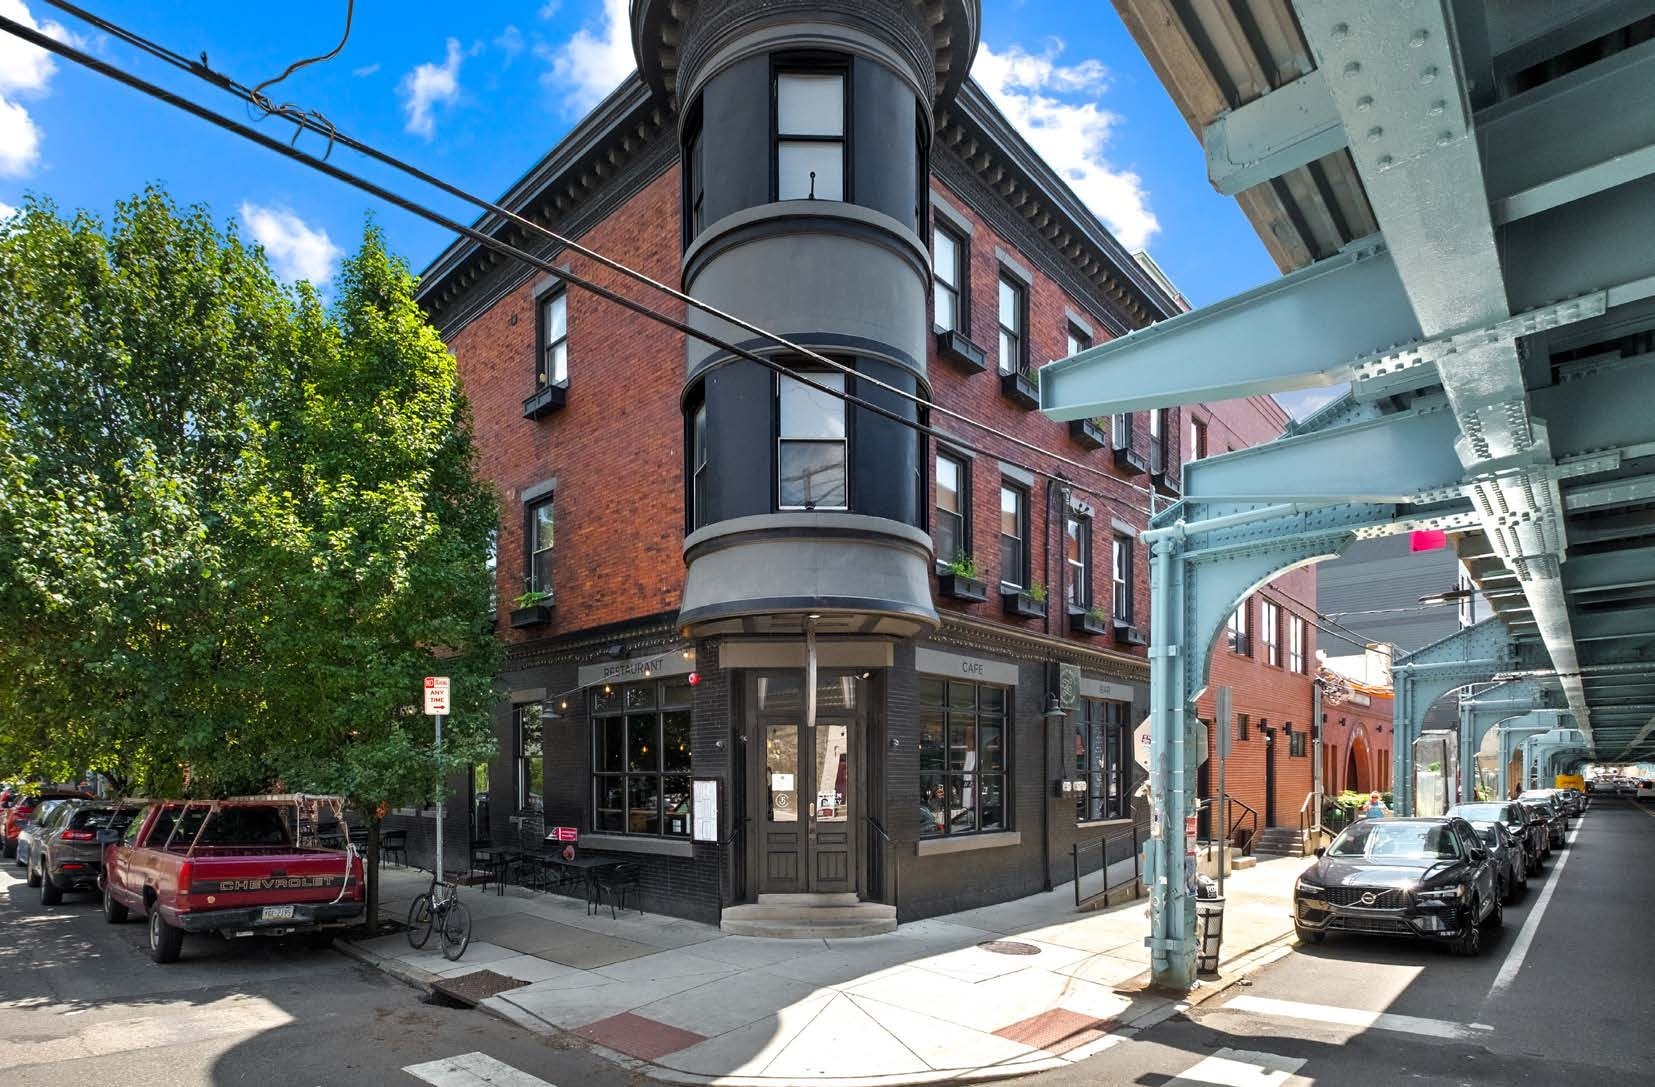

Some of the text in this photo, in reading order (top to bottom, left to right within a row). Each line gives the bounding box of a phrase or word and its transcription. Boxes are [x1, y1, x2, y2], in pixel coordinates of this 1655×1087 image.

[603, 659, 663, 677] RESTAURANT
[962, 662, 984, 675] CAFE
[220, 877, 334, 891] CHEVROLET
